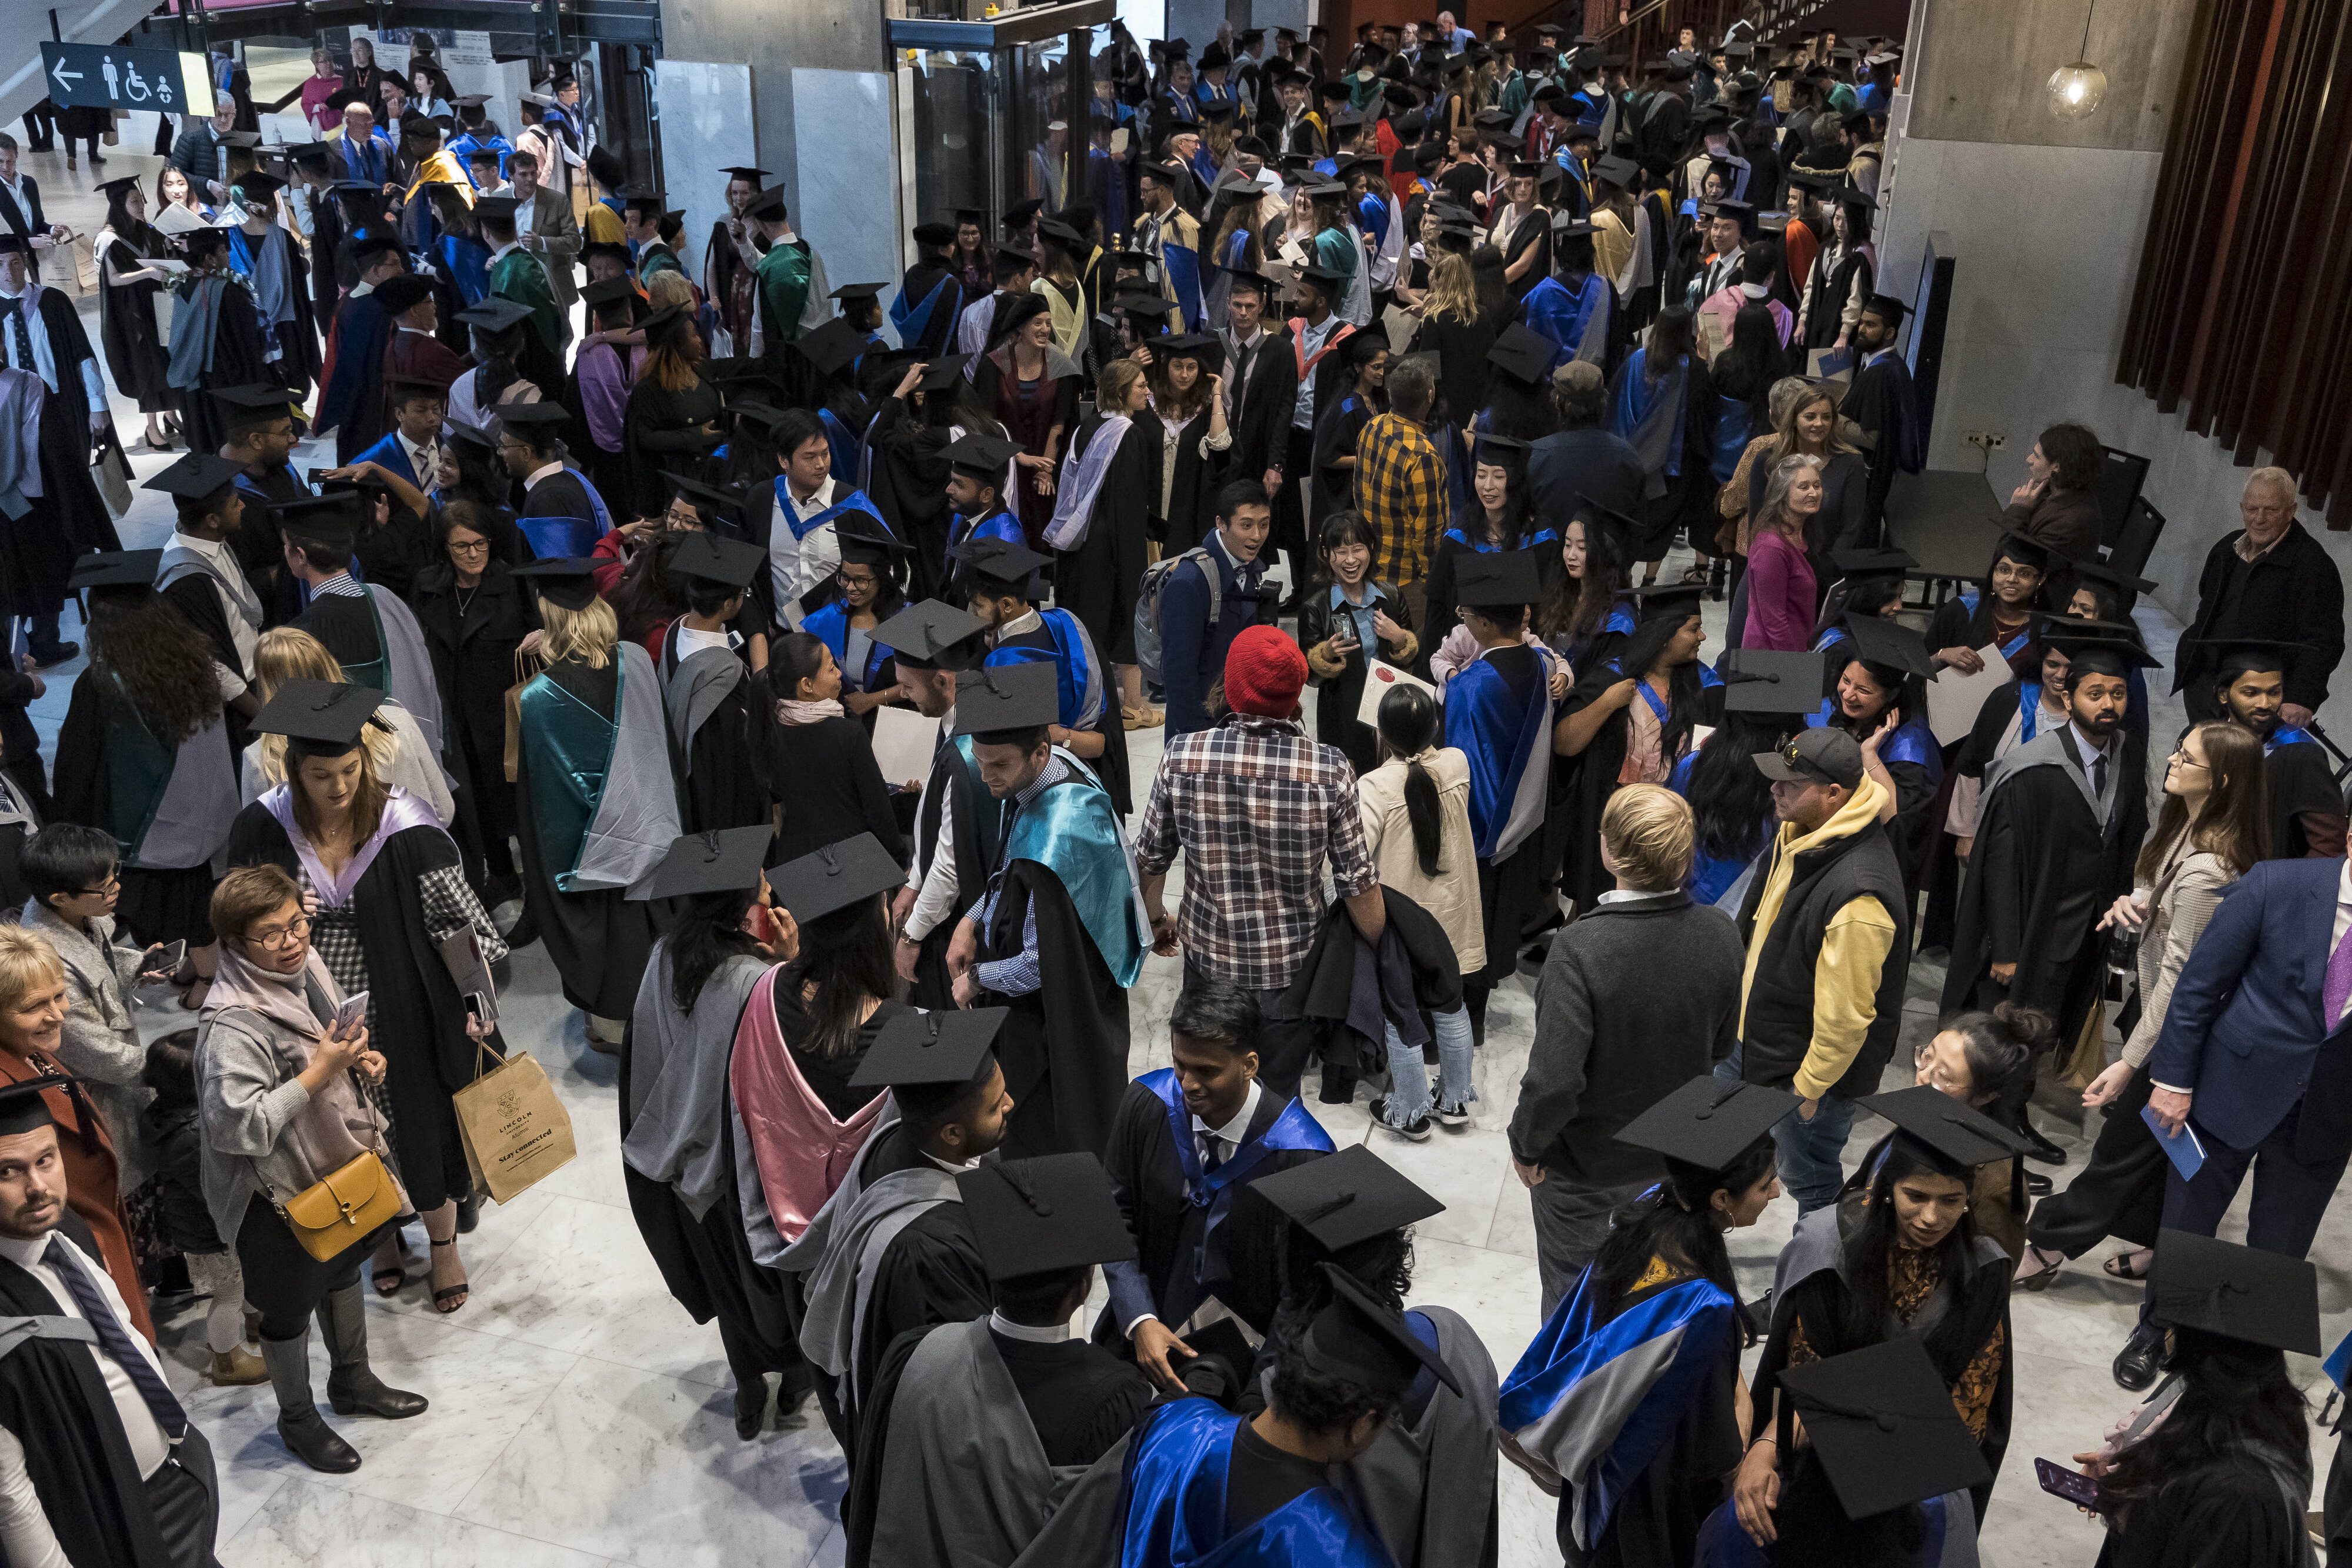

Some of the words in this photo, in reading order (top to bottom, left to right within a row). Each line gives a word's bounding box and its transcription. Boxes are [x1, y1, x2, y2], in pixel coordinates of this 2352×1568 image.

[499, 1111, 532, 1133] LINCOLN
[506, 1120, 529, 1135] UNIVERSITY
[512, 1127, 529, 1140] Alumni
[499, 1151, 514, 1164] Stay
[515, 1128, 552, 1153] connected
